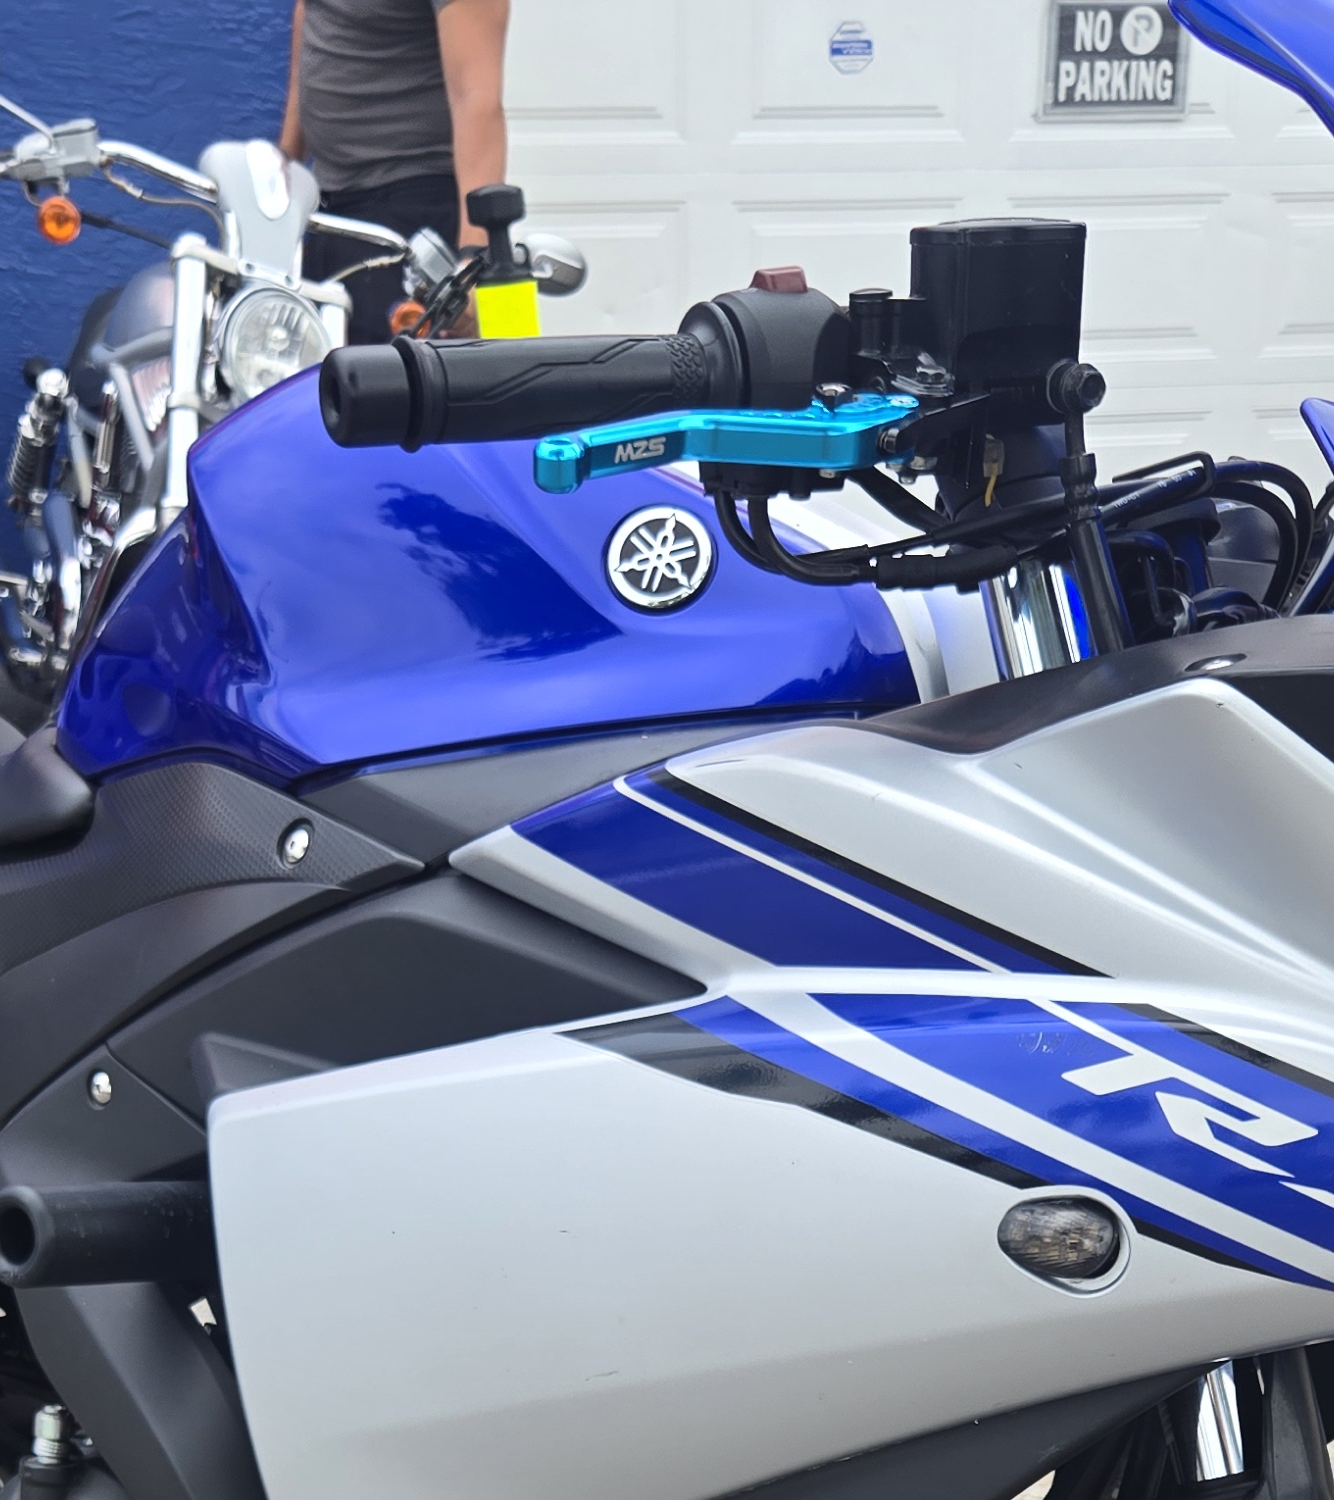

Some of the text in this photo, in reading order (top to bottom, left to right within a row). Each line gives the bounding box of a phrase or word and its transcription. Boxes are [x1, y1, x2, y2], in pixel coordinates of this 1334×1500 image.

[1074, 9, 1113, 52] NO
[1058, 58, 1174, 102] PARKING
[614, 436, 666, 464] MZS
